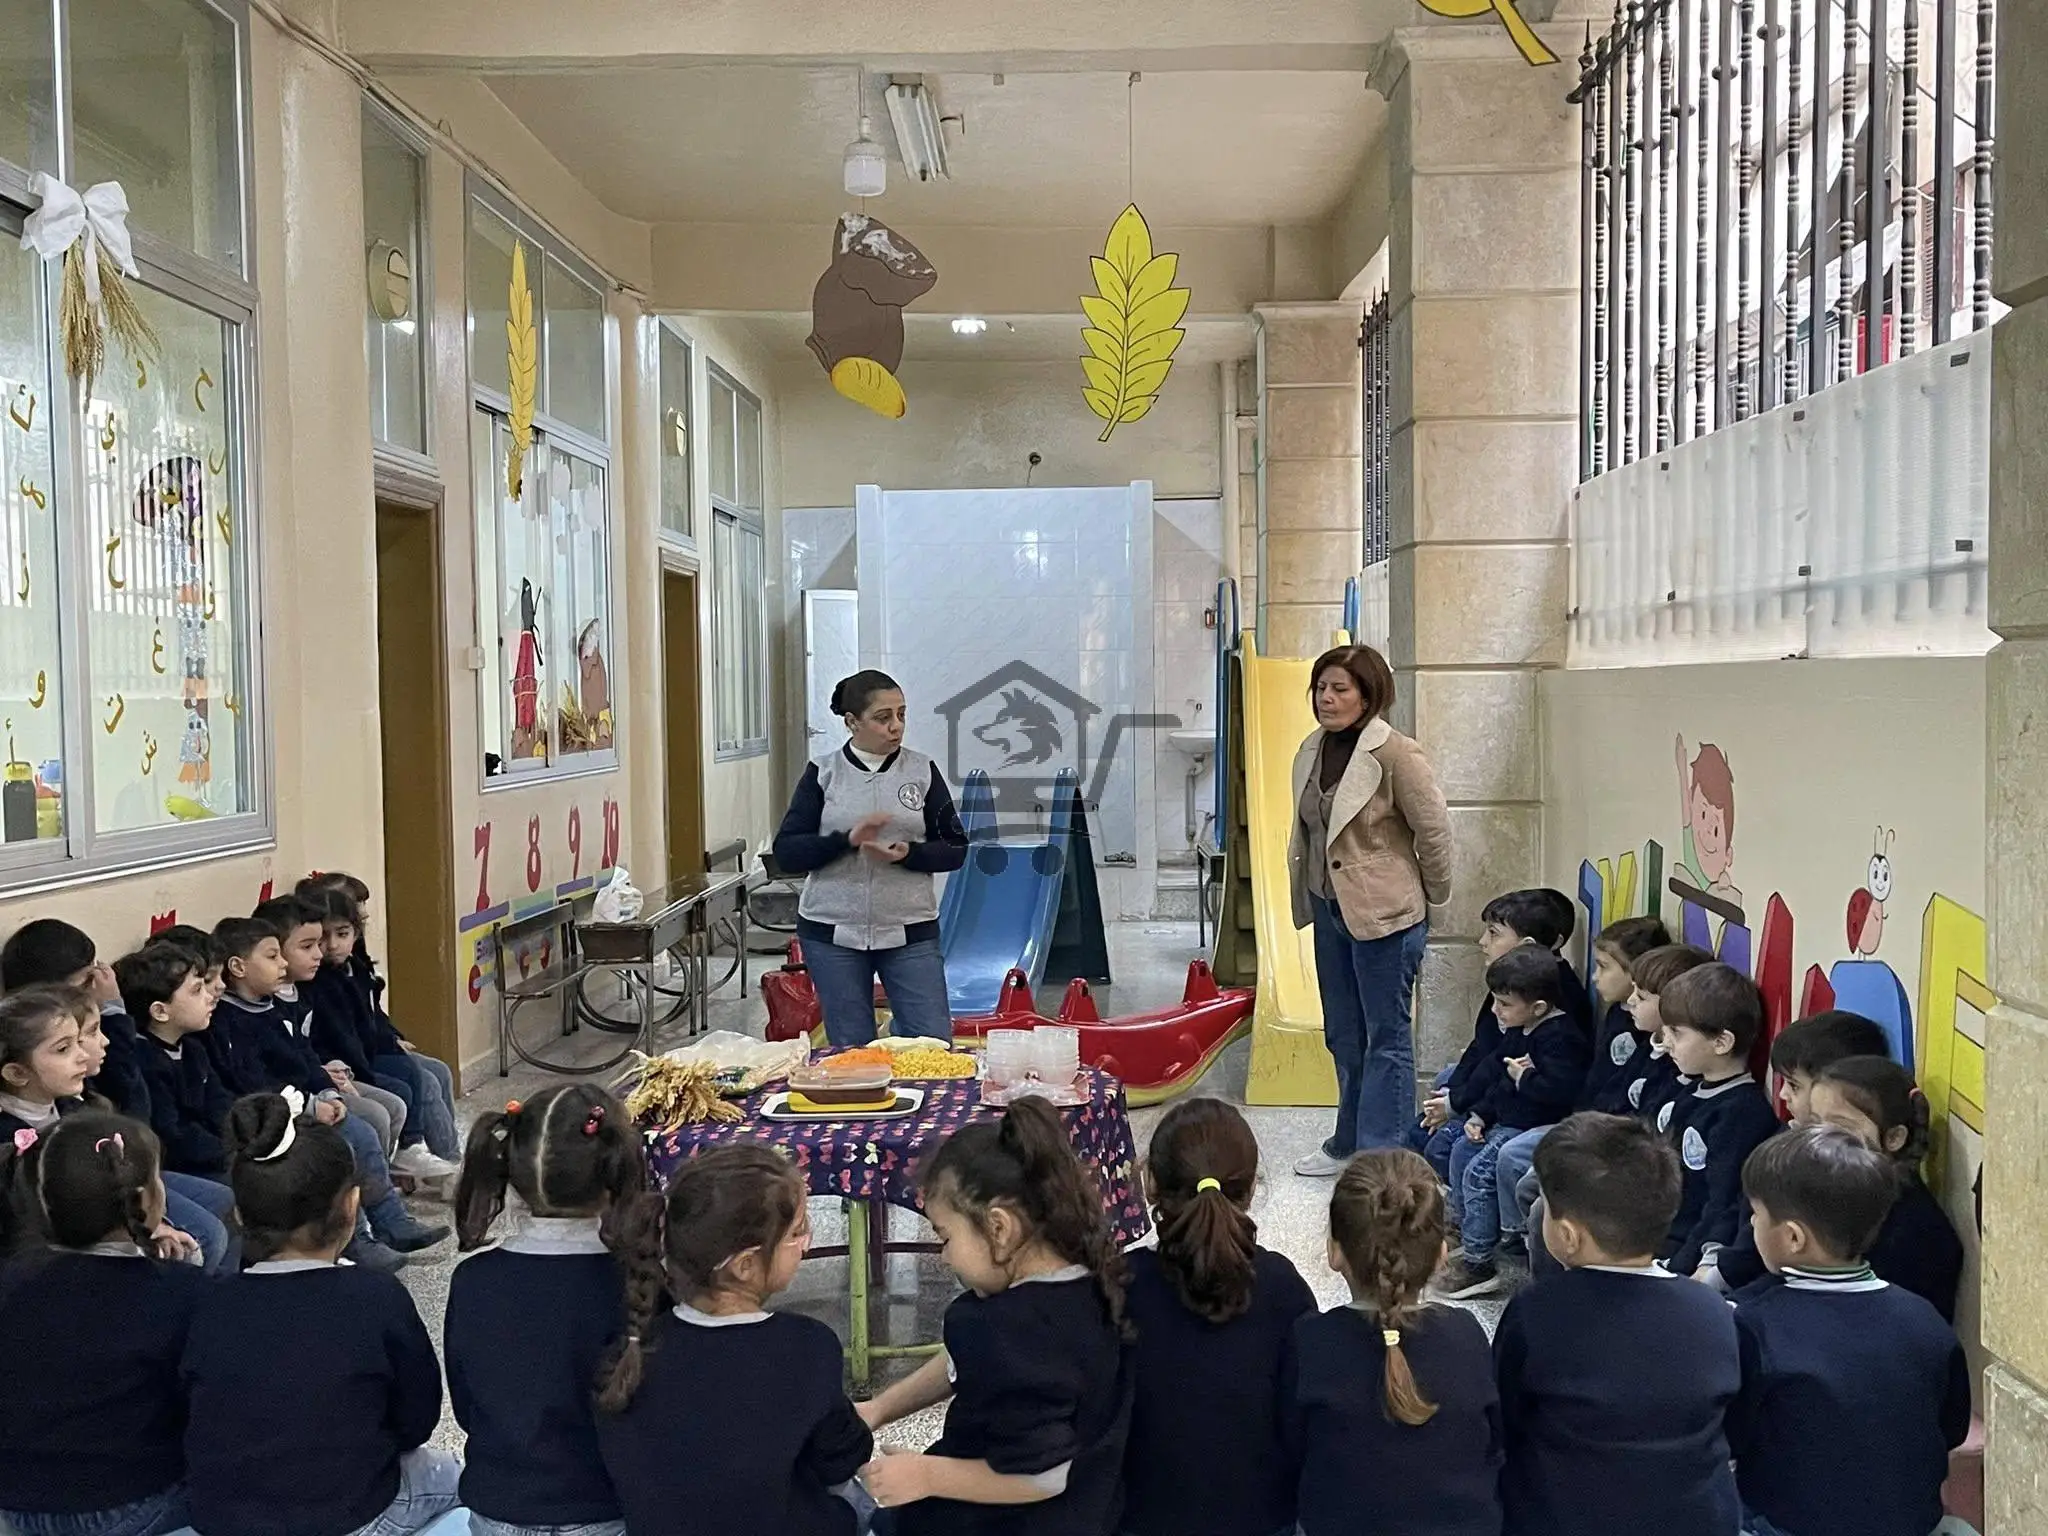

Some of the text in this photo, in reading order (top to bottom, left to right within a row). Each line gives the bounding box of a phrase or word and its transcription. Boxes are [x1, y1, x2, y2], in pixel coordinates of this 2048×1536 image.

[106, 528, 125, 589] خ
[152, 615, 167, 674] غ
[29, 669, 46, 709] و
[474, 798, 619, 914] 7 8 9 10
